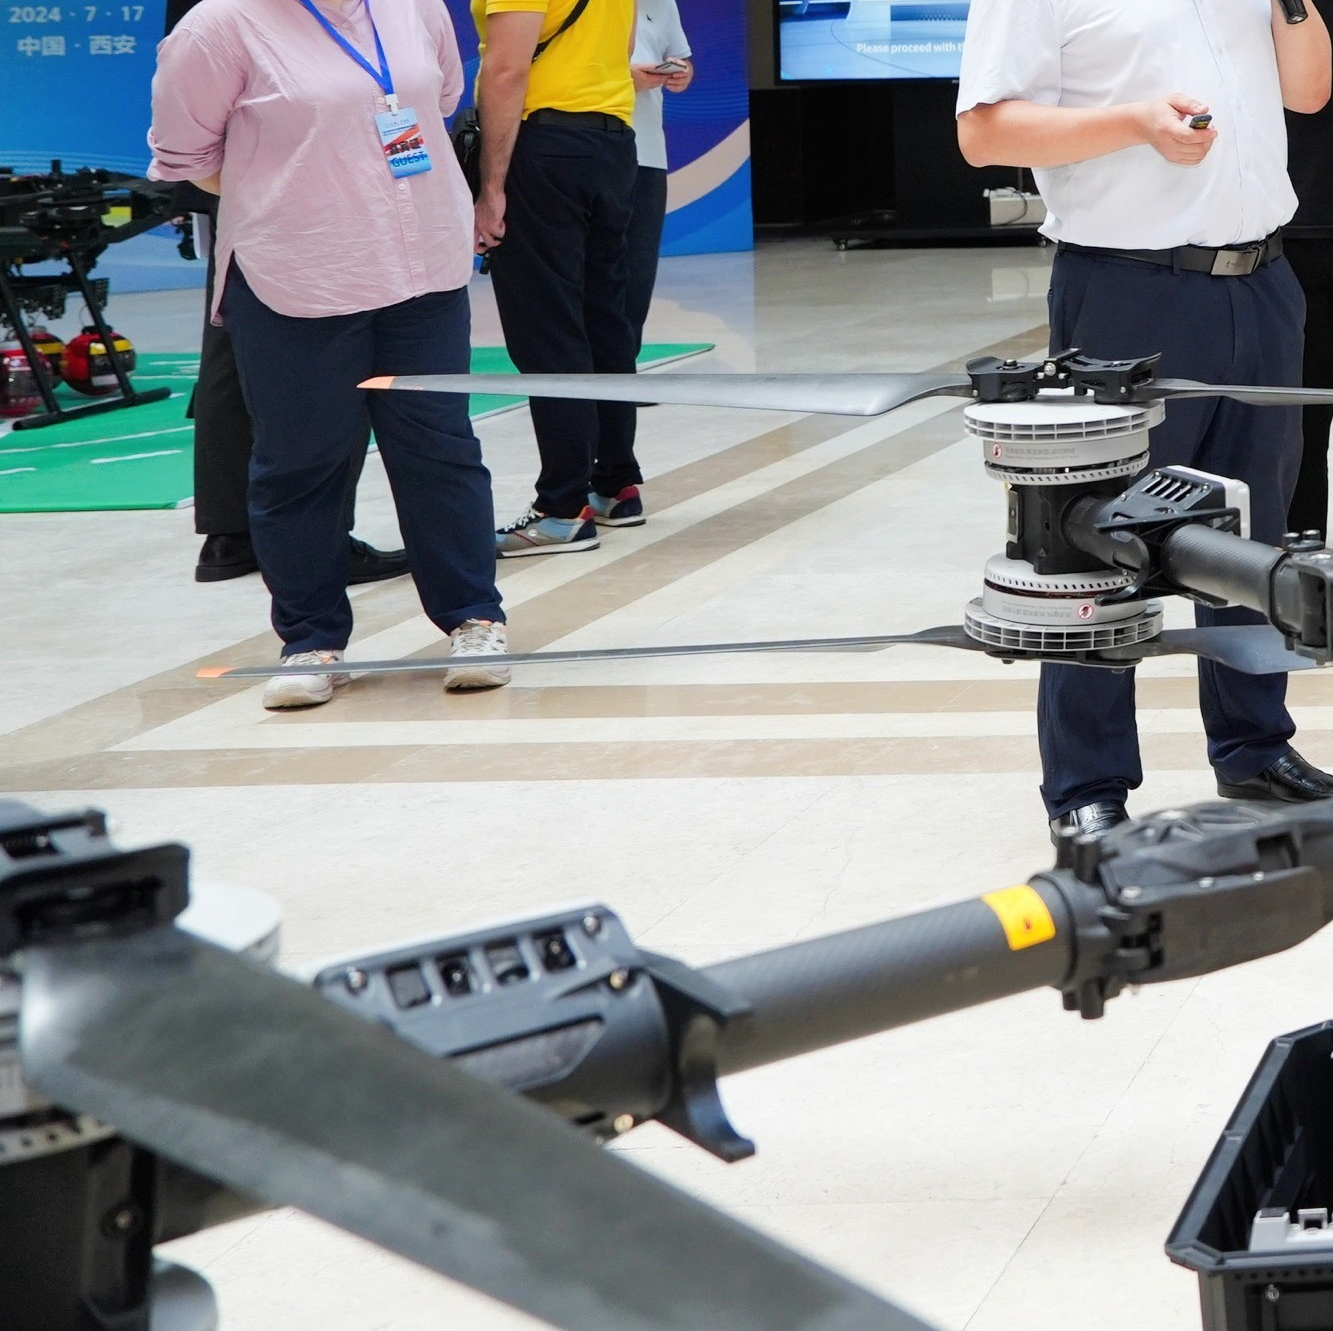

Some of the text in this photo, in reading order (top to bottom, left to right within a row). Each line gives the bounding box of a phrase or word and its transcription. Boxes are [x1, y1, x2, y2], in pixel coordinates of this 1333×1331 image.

[856, 42, 889, 54] Please
[891, 42, 931, 55] proceed
[934, 41, 956, 52] with
[391, 150, 428, 168] GUEST
